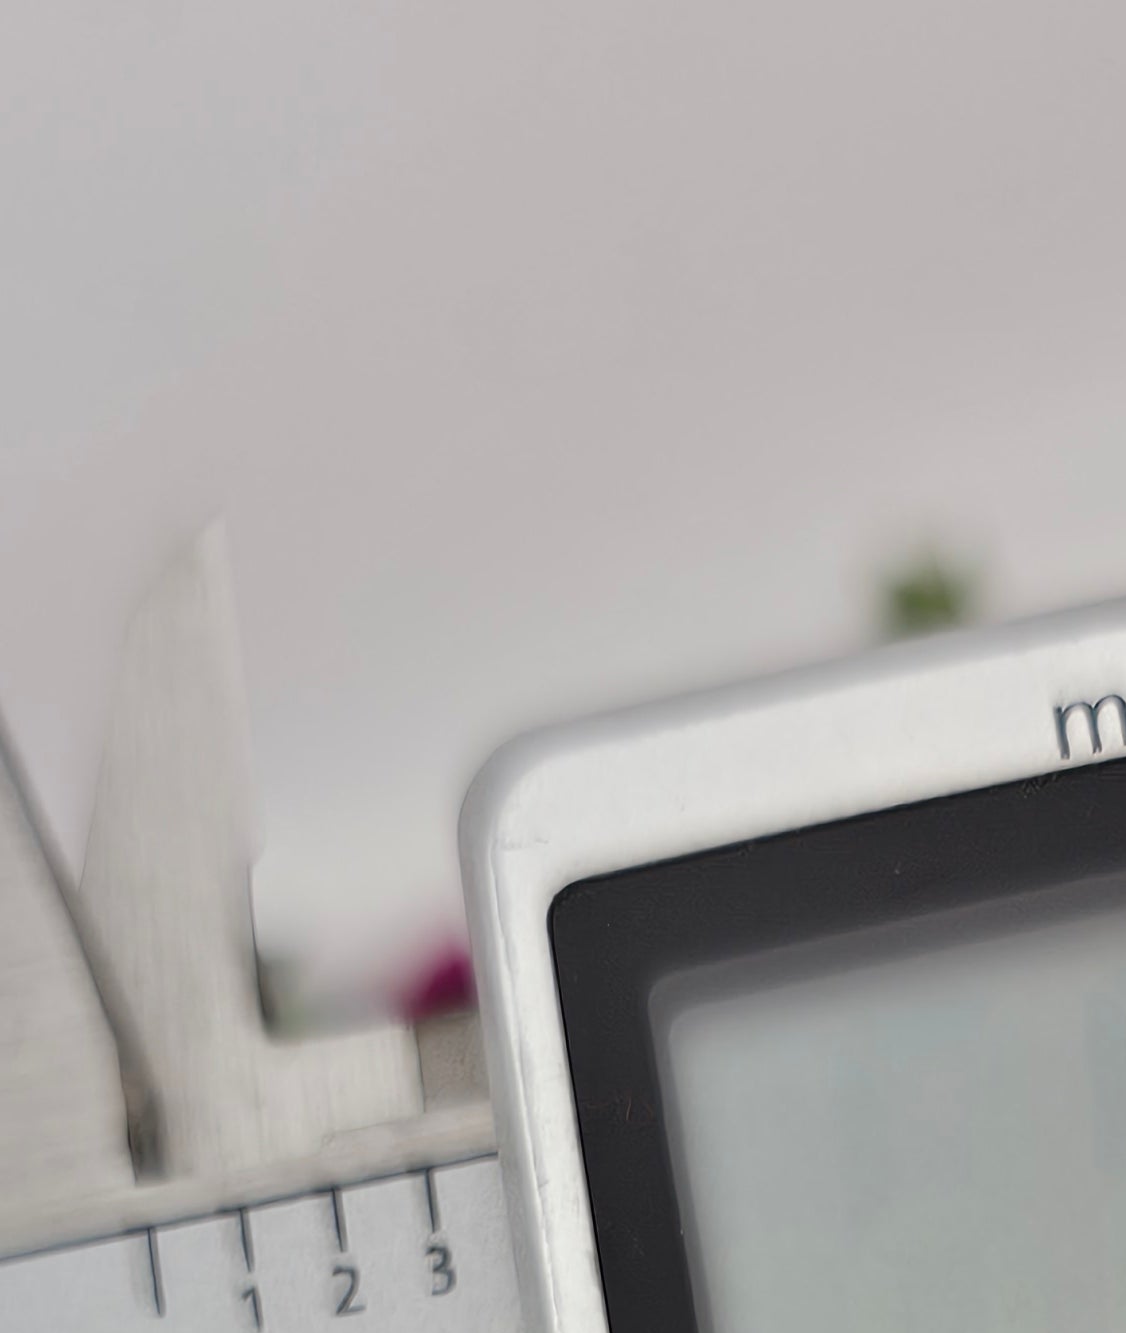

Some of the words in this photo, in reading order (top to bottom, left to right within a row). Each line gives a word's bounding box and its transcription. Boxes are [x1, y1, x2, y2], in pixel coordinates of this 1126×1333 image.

[241, 1284, 264, 1333] 1
[331, 1265, 367, 1317] 2
[424, 1245, 457, 1296] 3
